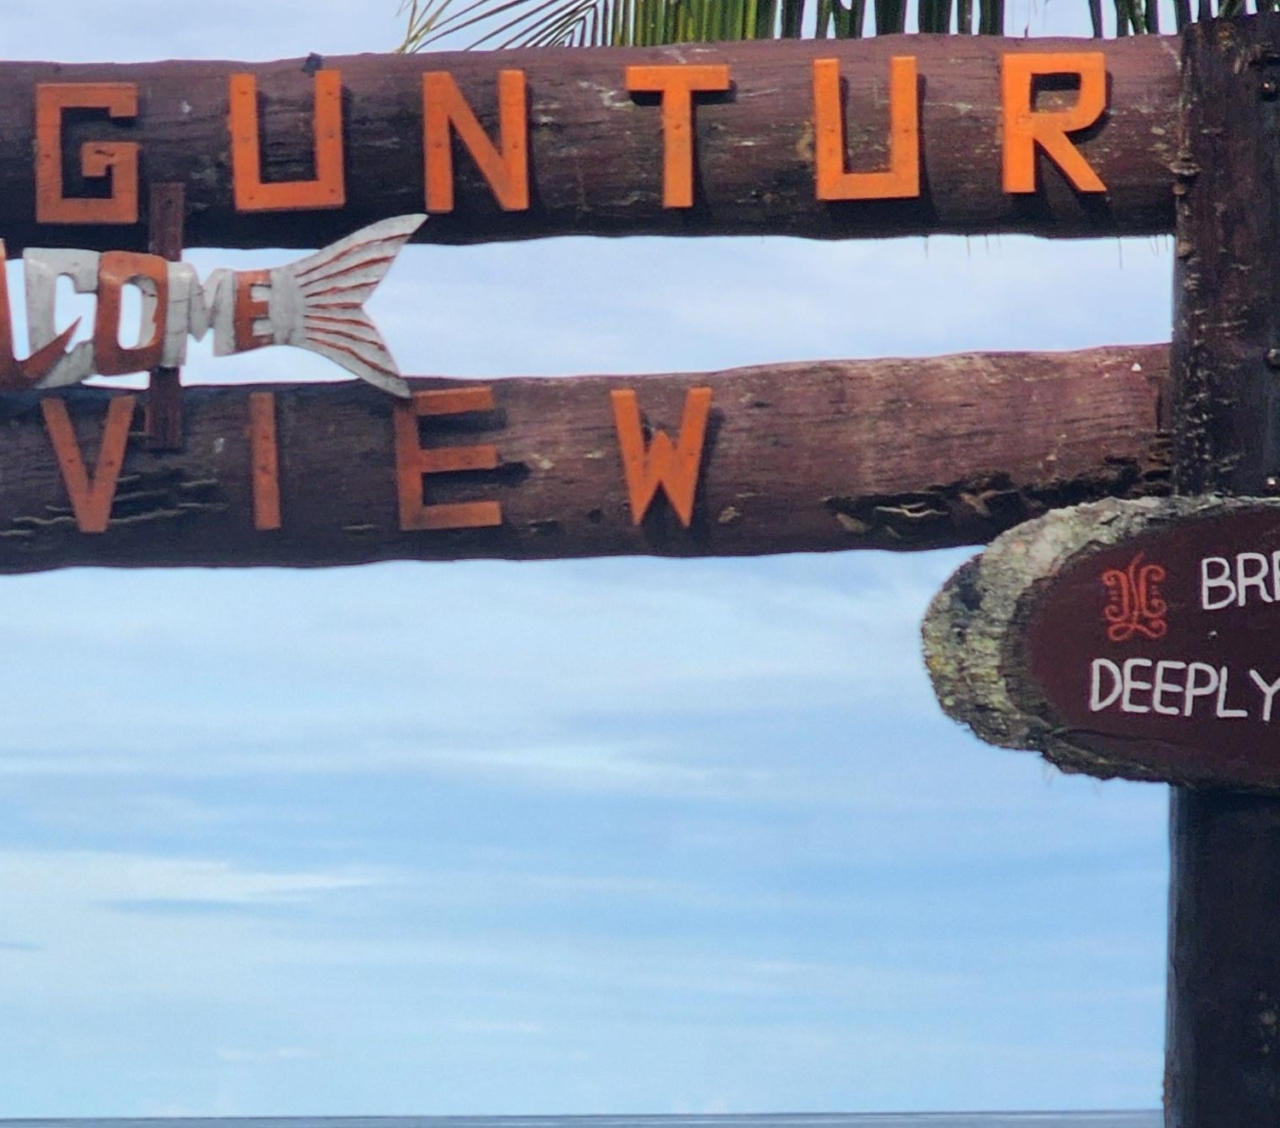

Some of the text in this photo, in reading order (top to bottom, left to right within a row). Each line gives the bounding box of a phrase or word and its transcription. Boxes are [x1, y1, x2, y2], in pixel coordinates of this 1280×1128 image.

[35, 52, 1107, 225] GUNTUR
[41, 387, 712, 534] VIEW
[1090, 657, 1280, 722] DEEPLY
